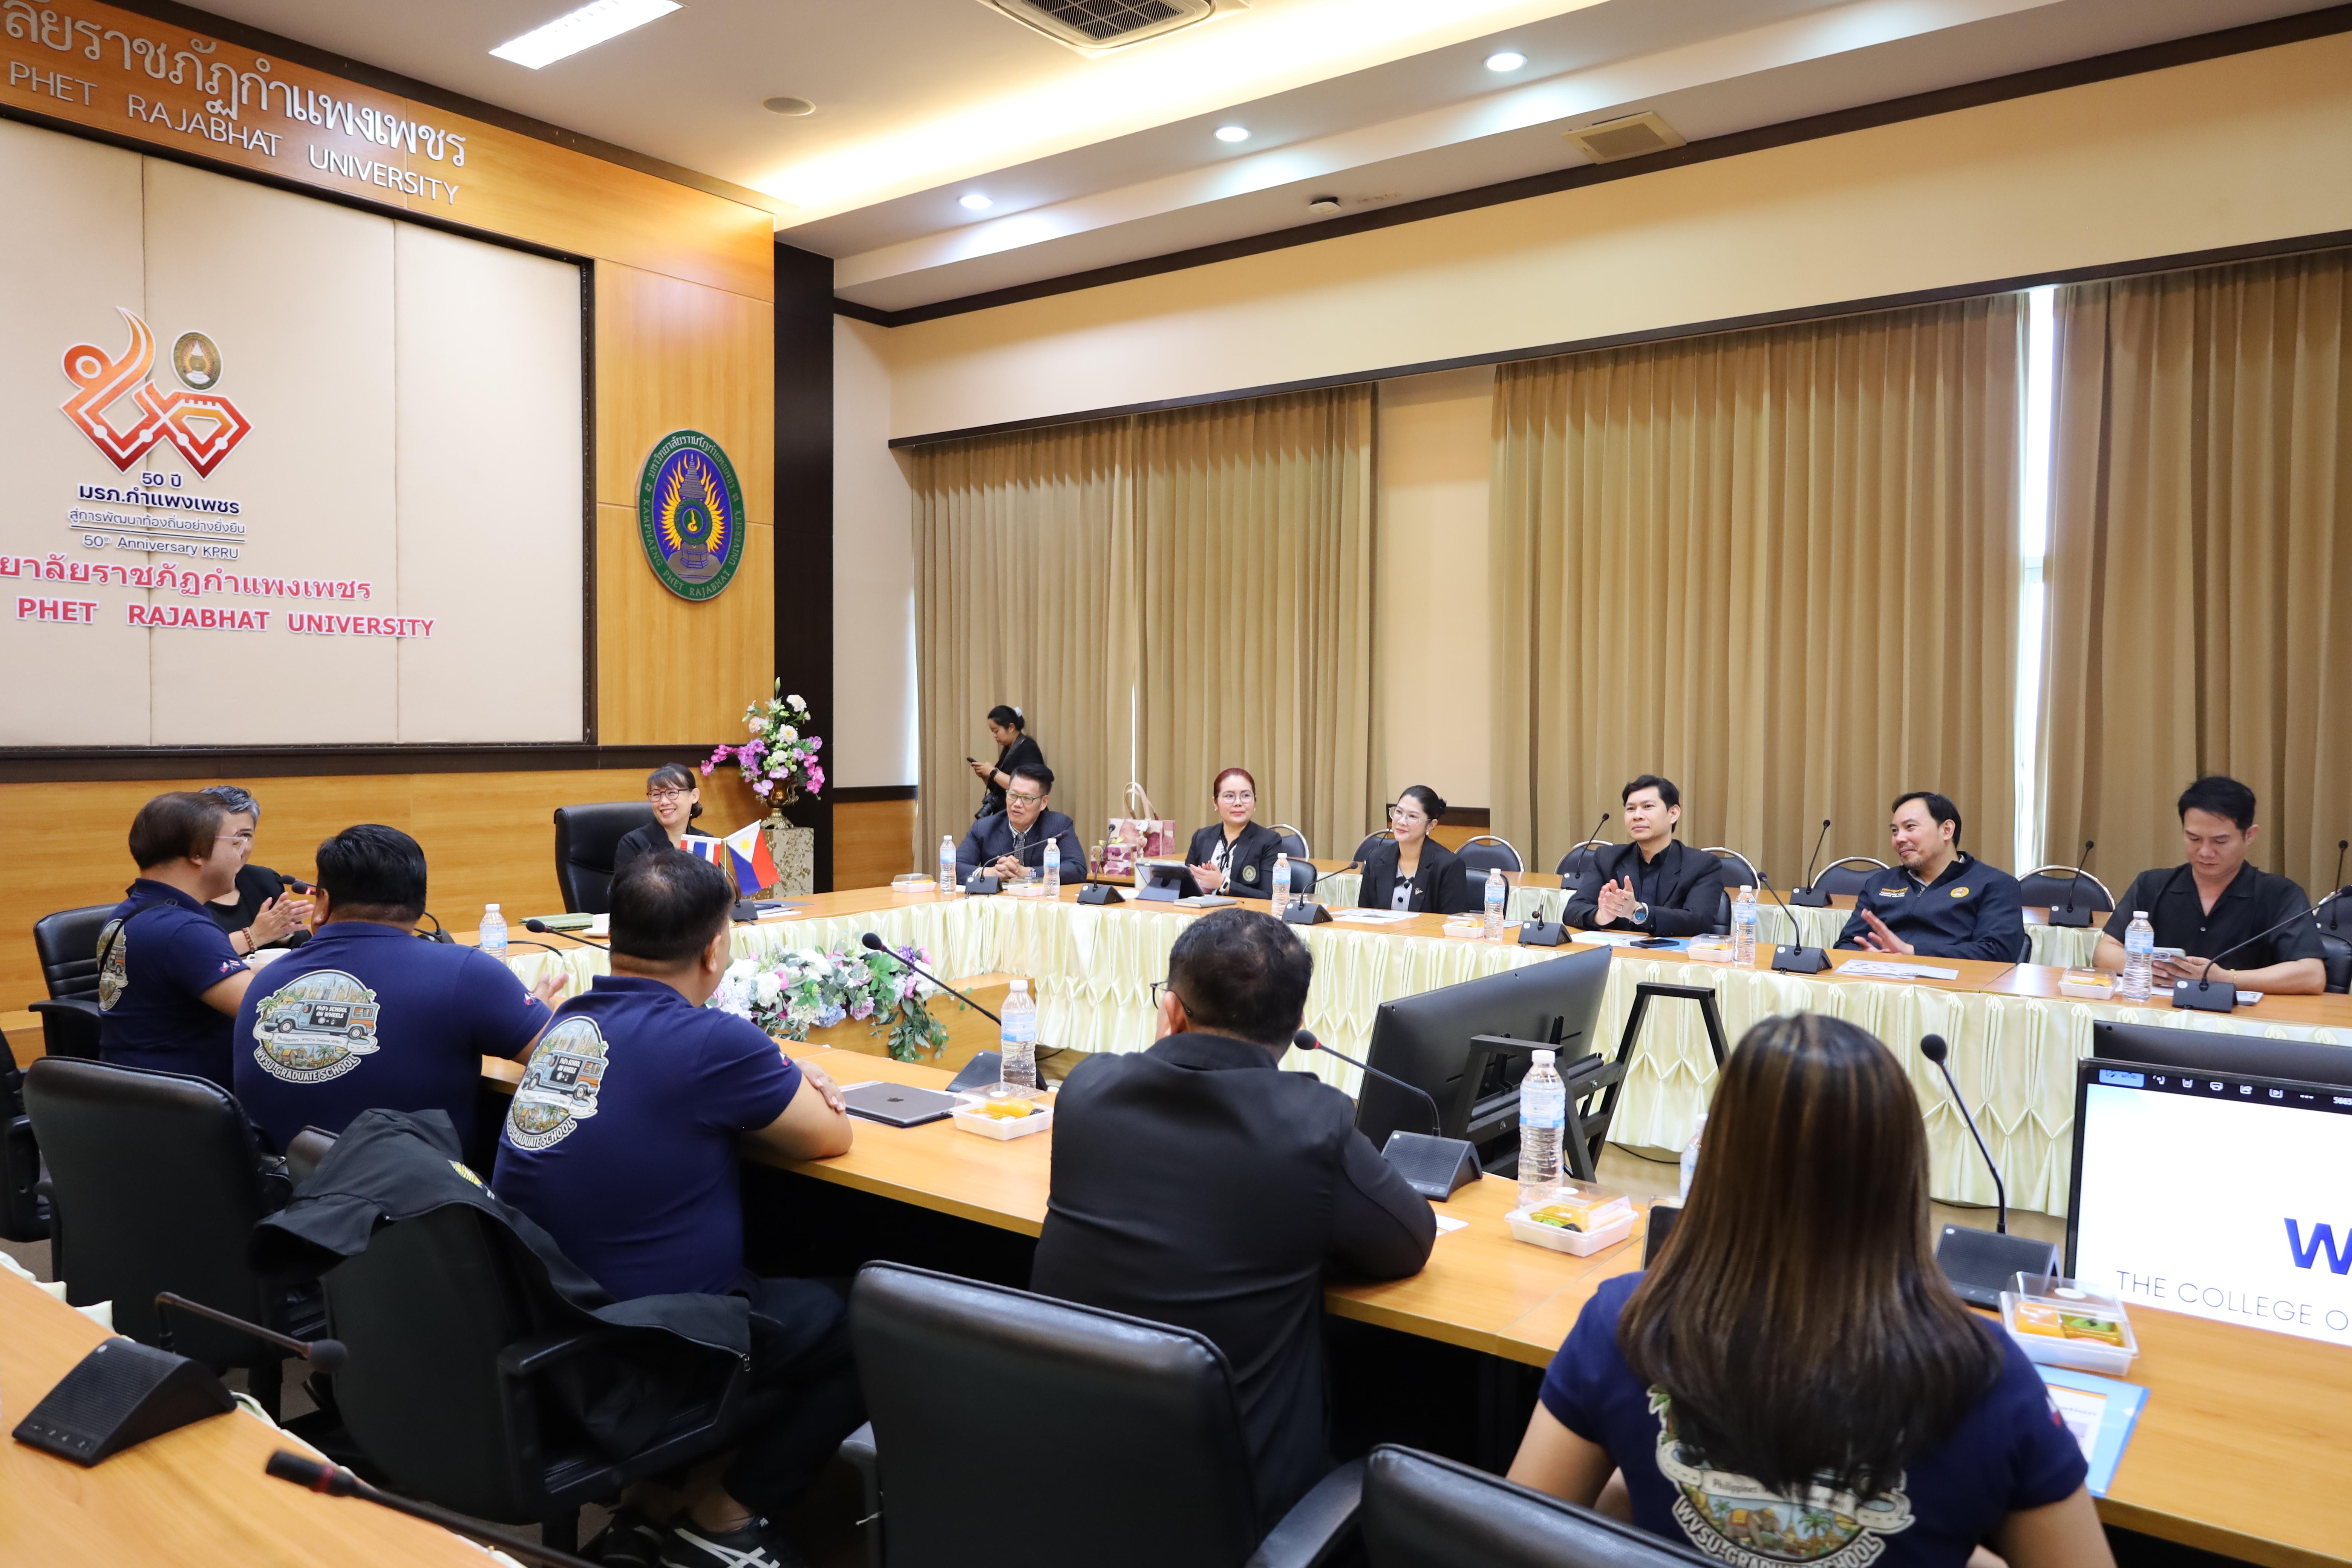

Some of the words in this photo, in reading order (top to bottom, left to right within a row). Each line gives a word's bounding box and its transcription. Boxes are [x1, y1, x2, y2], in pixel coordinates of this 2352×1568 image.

[3, 0, 466, 167] ลยราชภัฏกำแพงเพชร
[10, 61, 98, 106] PHET
[127, 94, 283, 157] RAJABHAT
[309, 144, 459, 205] UNIVERSITY
[142, 472, 164, 485] 50
[171, 473, 182, 487] ปี
[79, 485, 240, 514] มรภ.กำแพงเพชร
[84, 534, 111, 547] 50th
[118, 537, 198, 556] Anniversary
[203, 546, 239, 559] KPRU
[643, 499, 663, 567] KAMPHAENG
[663, 569, 685, 591] PHET
[689, 569, 730, 598] RAJABHAT
[728, 509, 742, 566] UNIVERSITY
[18, 598, 97, 622] PHET
[128, 605, 271, 631] RAJABHAT
[288, 613, 435, 637] UNIVERSITY
[254, 1047, 319, 1081] WVSU-GRADUATE
[320, 1056, 358, 1080] SCHOOL
[541, 1119, 574, 1147] SCHOOL
[2116, 1270, 2166, 1298] THE
[2178, 1283, 2312, 1325] COLLEGE
